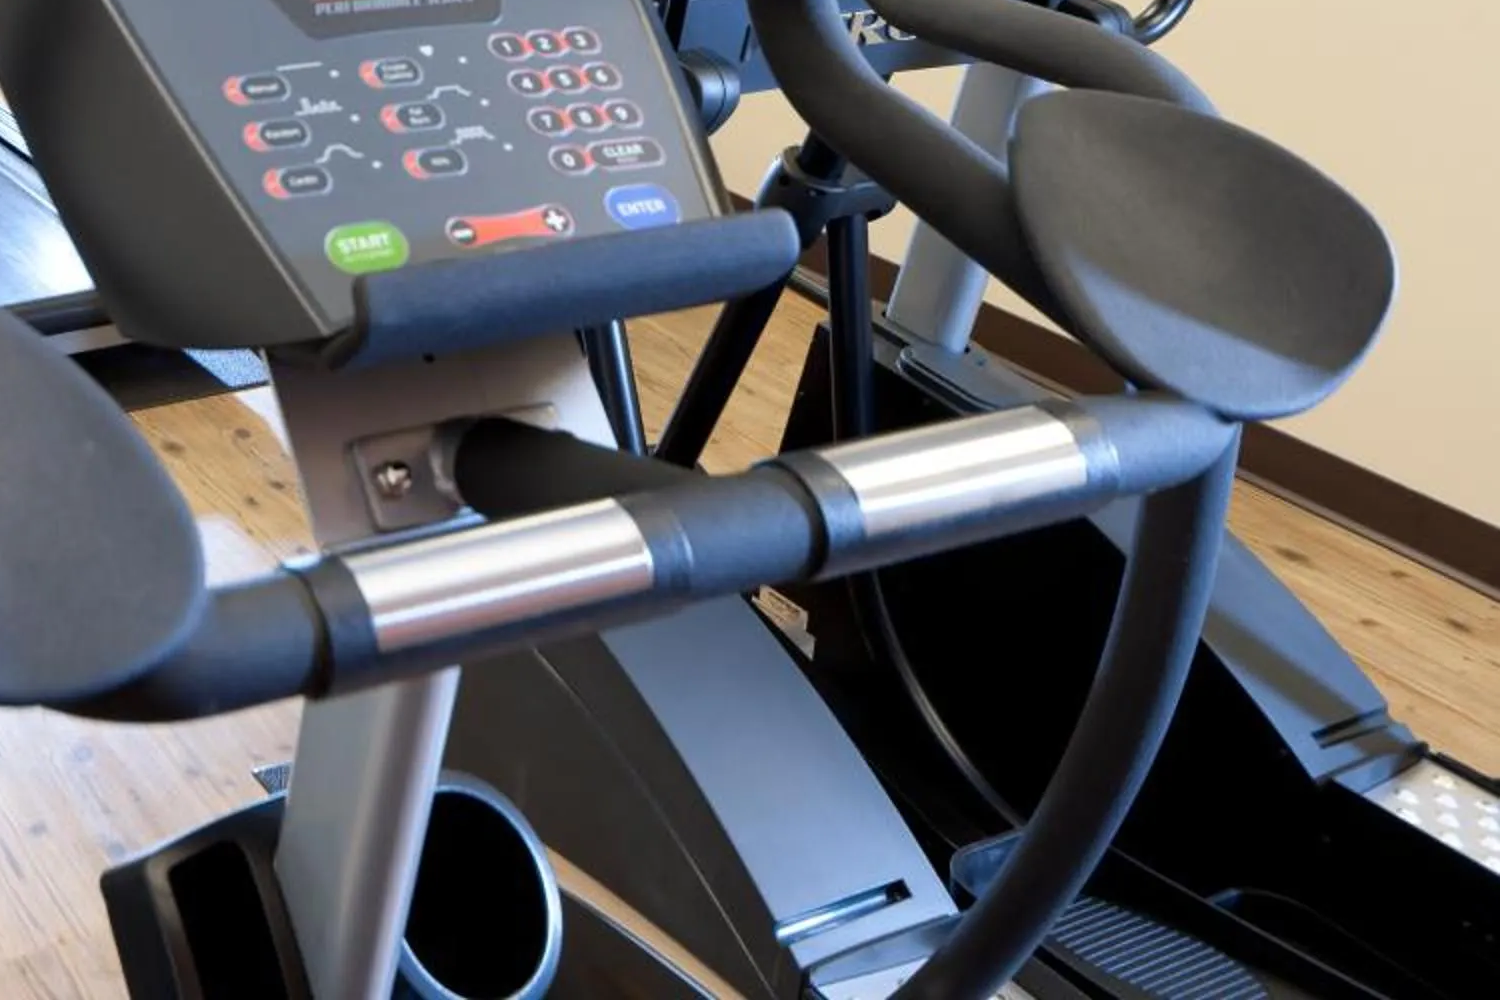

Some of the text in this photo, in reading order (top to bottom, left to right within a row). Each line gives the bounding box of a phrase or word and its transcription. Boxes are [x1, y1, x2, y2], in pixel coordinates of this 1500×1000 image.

[501, 33, 587, 54] 1 2 3
[521, 76, 534, 90] 4
[595, 69, 609, 84] 6
[540, 105, 629, 129] 7 8 9
[560, 143, 646, 168] 0 CLEAR
[615, 198, 668, 217] ENTER
[335, 232, 390, 255] START
